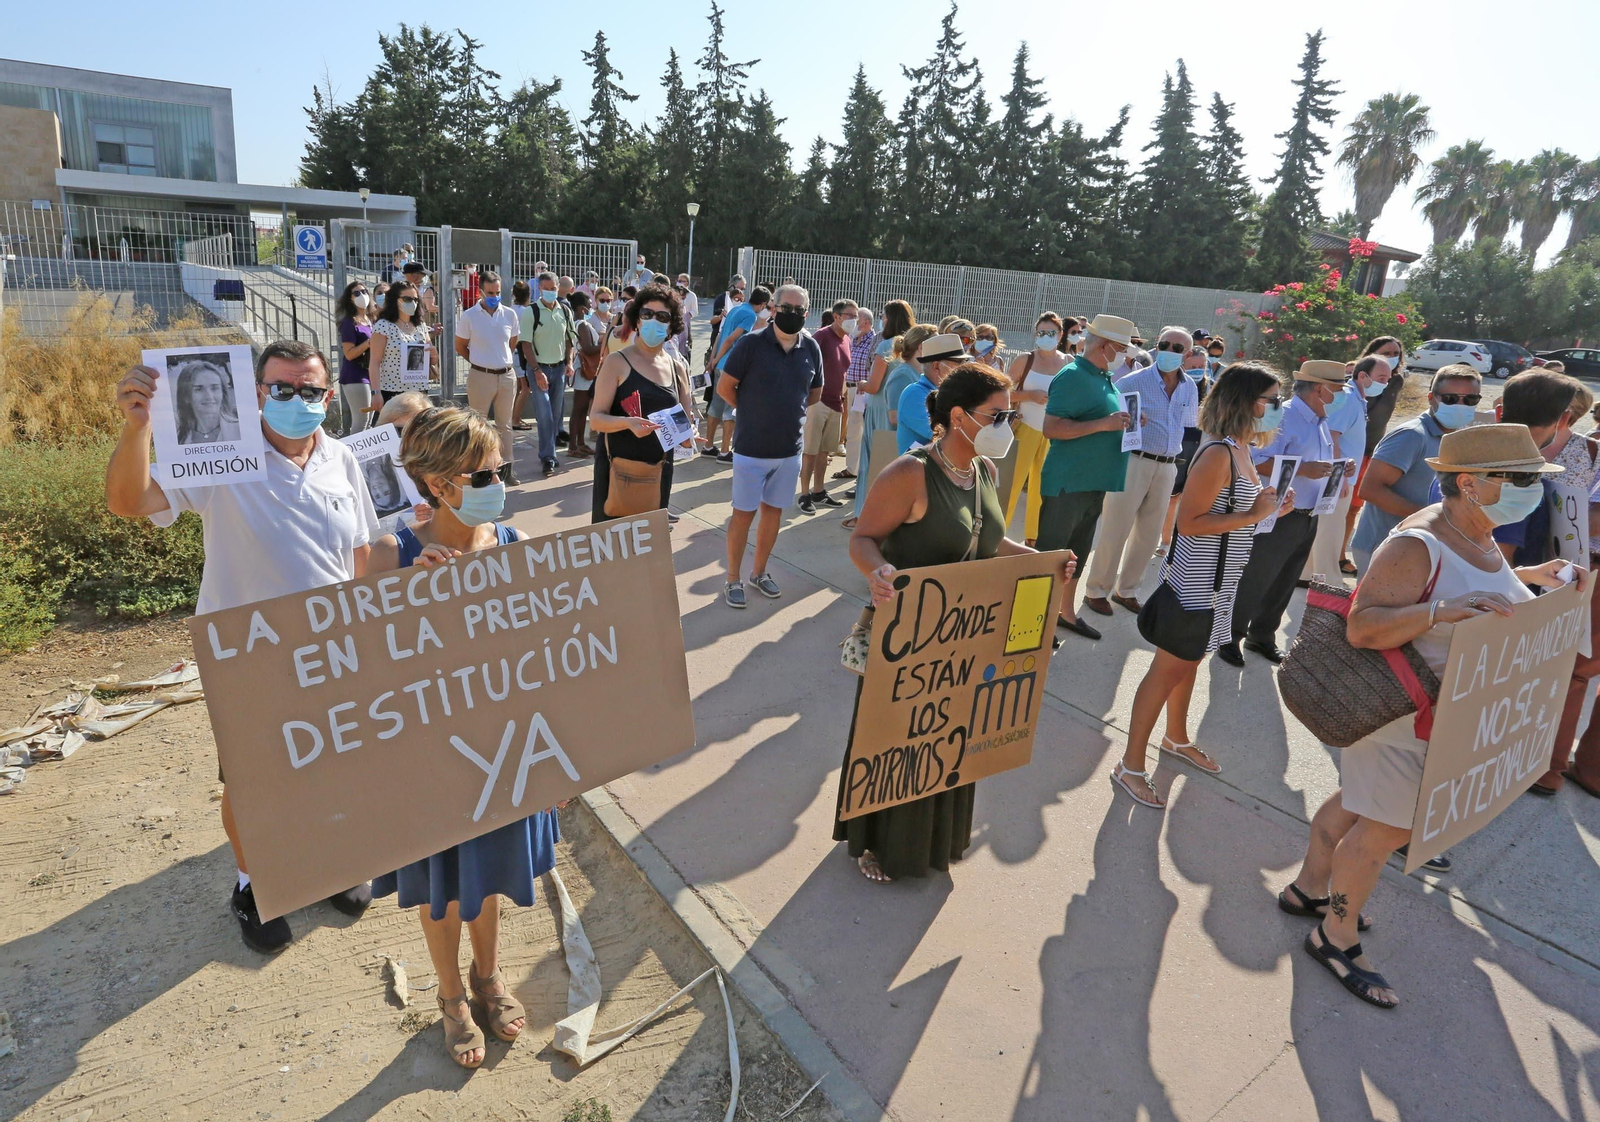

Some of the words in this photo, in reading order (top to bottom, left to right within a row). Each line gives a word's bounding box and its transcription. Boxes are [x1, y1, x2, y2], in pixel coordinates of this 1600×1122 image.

[172, 456, 259, 479] DIMISIÓN
[184, 444, 236, 456] DIRECTORA
[346, 430, 390, 453] DIMISI
[356, 447, 385, 461] DIRECTOR
[207, 610, 281, 661] LA
[293, 634, 359, 688] EN
[385, 616, 444, 661] LA
[463, 576, 598, 639] PRENSA
[891, 651, 976, 703] ESTÁN
[1452, 643, 1487, 702] LA
[907, 697, 951, 739] LOS
[1473, 696, 1511, 752] NO
[1508, 677, 1541, 733] SE
[450, 712, 581, 822] YA
[845, 725, 967, 813] PATRONOS?
[1422, 712, 1557, 843] EXTERNALIZA
